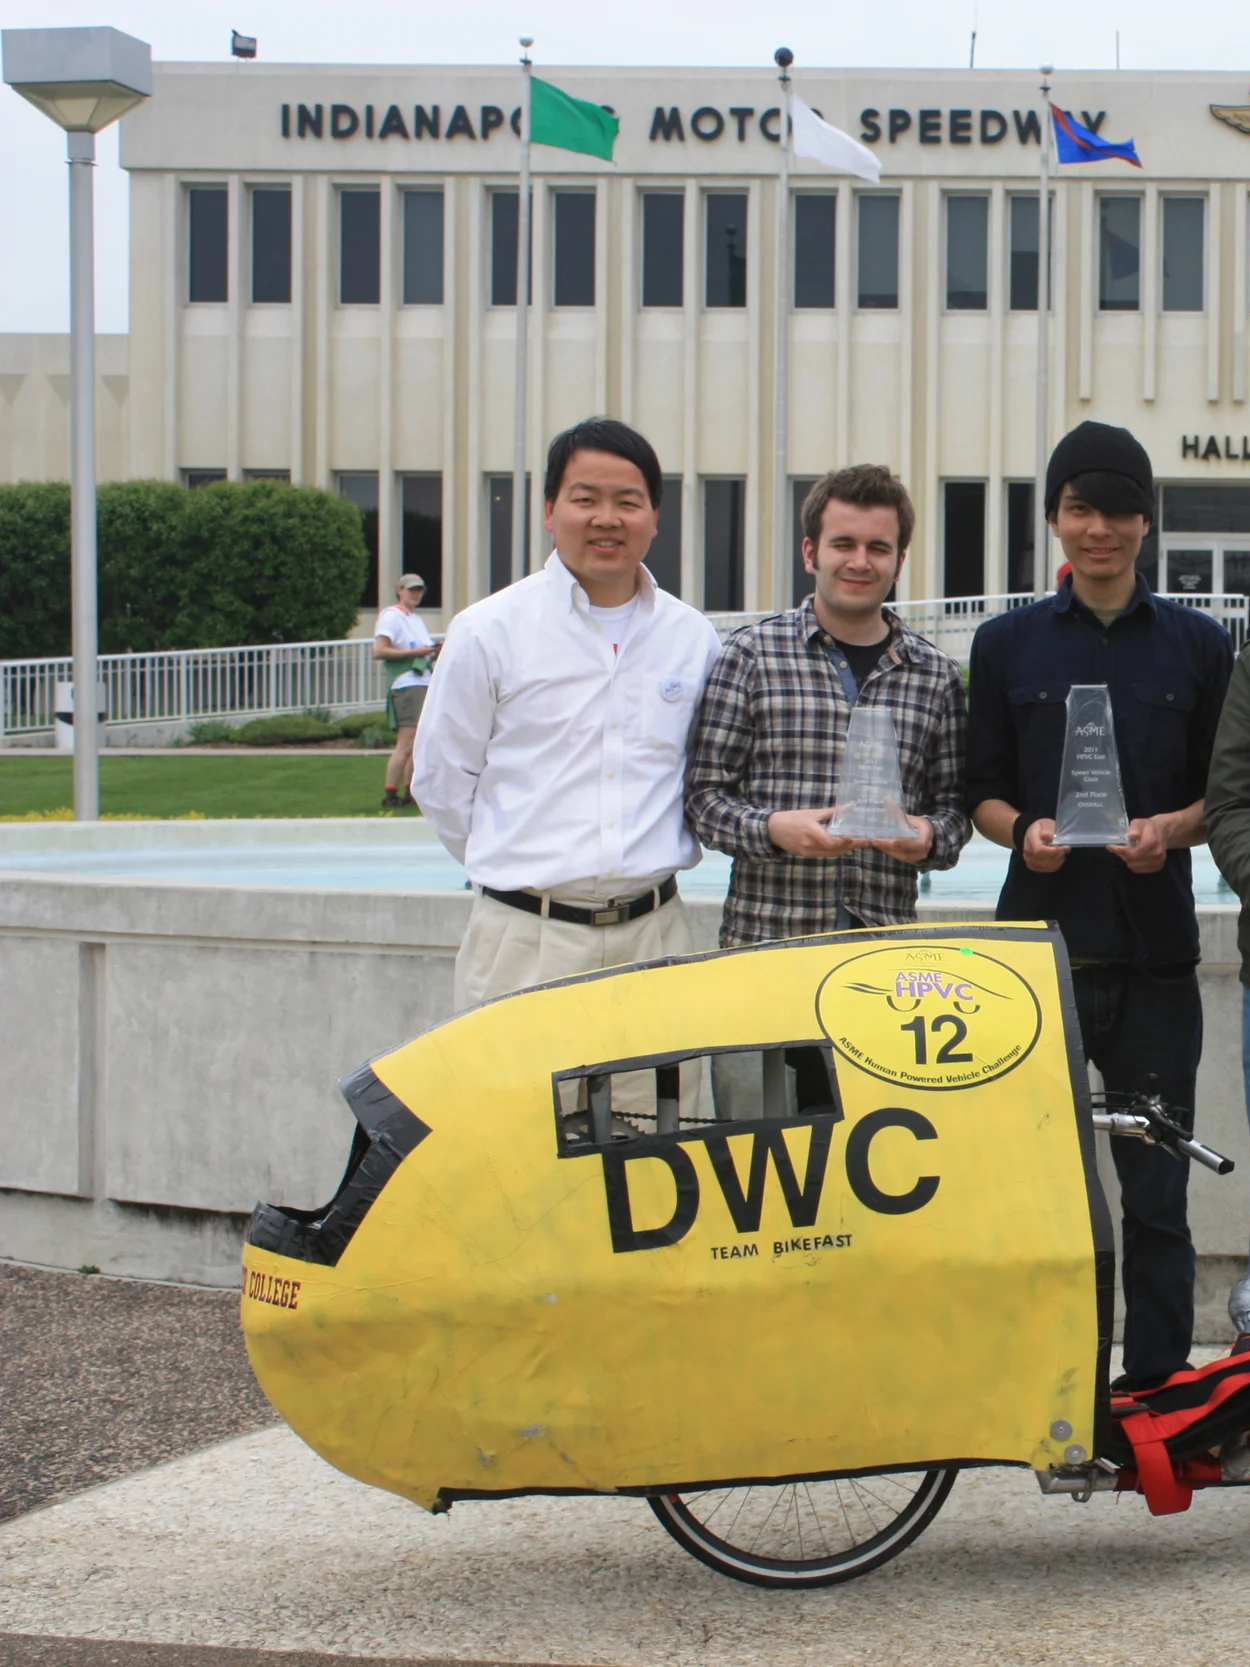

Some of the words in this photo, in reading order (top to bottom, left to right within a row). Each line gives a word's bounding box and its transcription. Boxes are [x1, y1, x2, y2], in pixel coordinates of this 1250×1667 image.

[281, 104, 616, 142] INDIANAP
[649, 106, 824, 143] MOTO
[860, 109, 1106, 146] SPEEDWY
[1074, 723, 1105, 737] ASME
[905, 949, 946, 962] ASME
[895, 981, 973, 1001] HPVC
[896, 971, 942, 983] ASME
[901, 1014, 974, 1065] 12
[838, 1037, 865, 1060] ASME
[864, 1056, 898, 1077] Human
[900, 1071, 943, 1084] Powered
[945, 1071, 980, 1083] Vehicle
[981, 1044, 1022, 1074] Challenge
[600, 1107, 941, 1254] DWC
[711, 1243, 759, 1260] TEAM
[773, 1234, 853, 1254] BIKEFAST
[248, 1270, 301, 1310] COLLEGE
